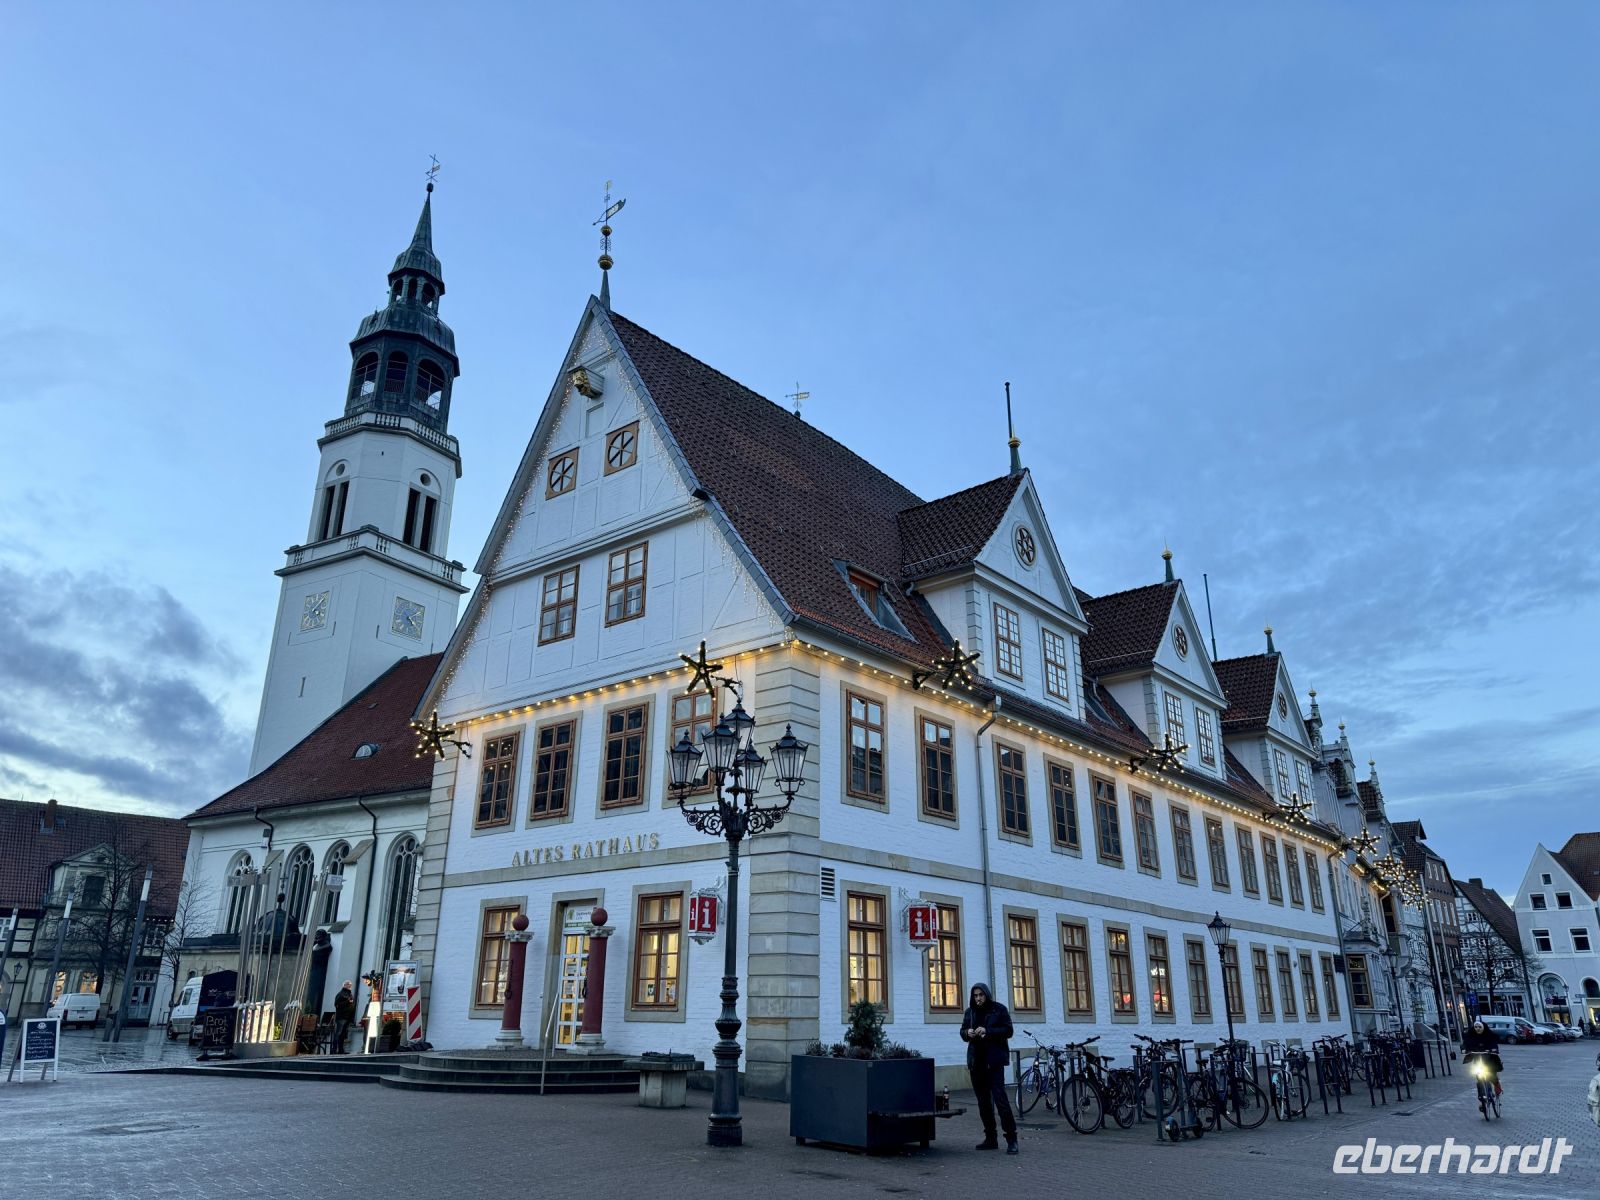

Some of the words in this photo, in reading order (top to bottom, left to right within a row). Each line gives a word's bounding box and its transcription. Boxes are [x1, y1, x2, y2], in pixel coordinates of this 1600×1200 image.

[511, 845, 564, 867] ALTES
[571, 832, 660, 860] RATHAUS
[701, 900, 711, 929] i
[914, 911, 925, 937] i
